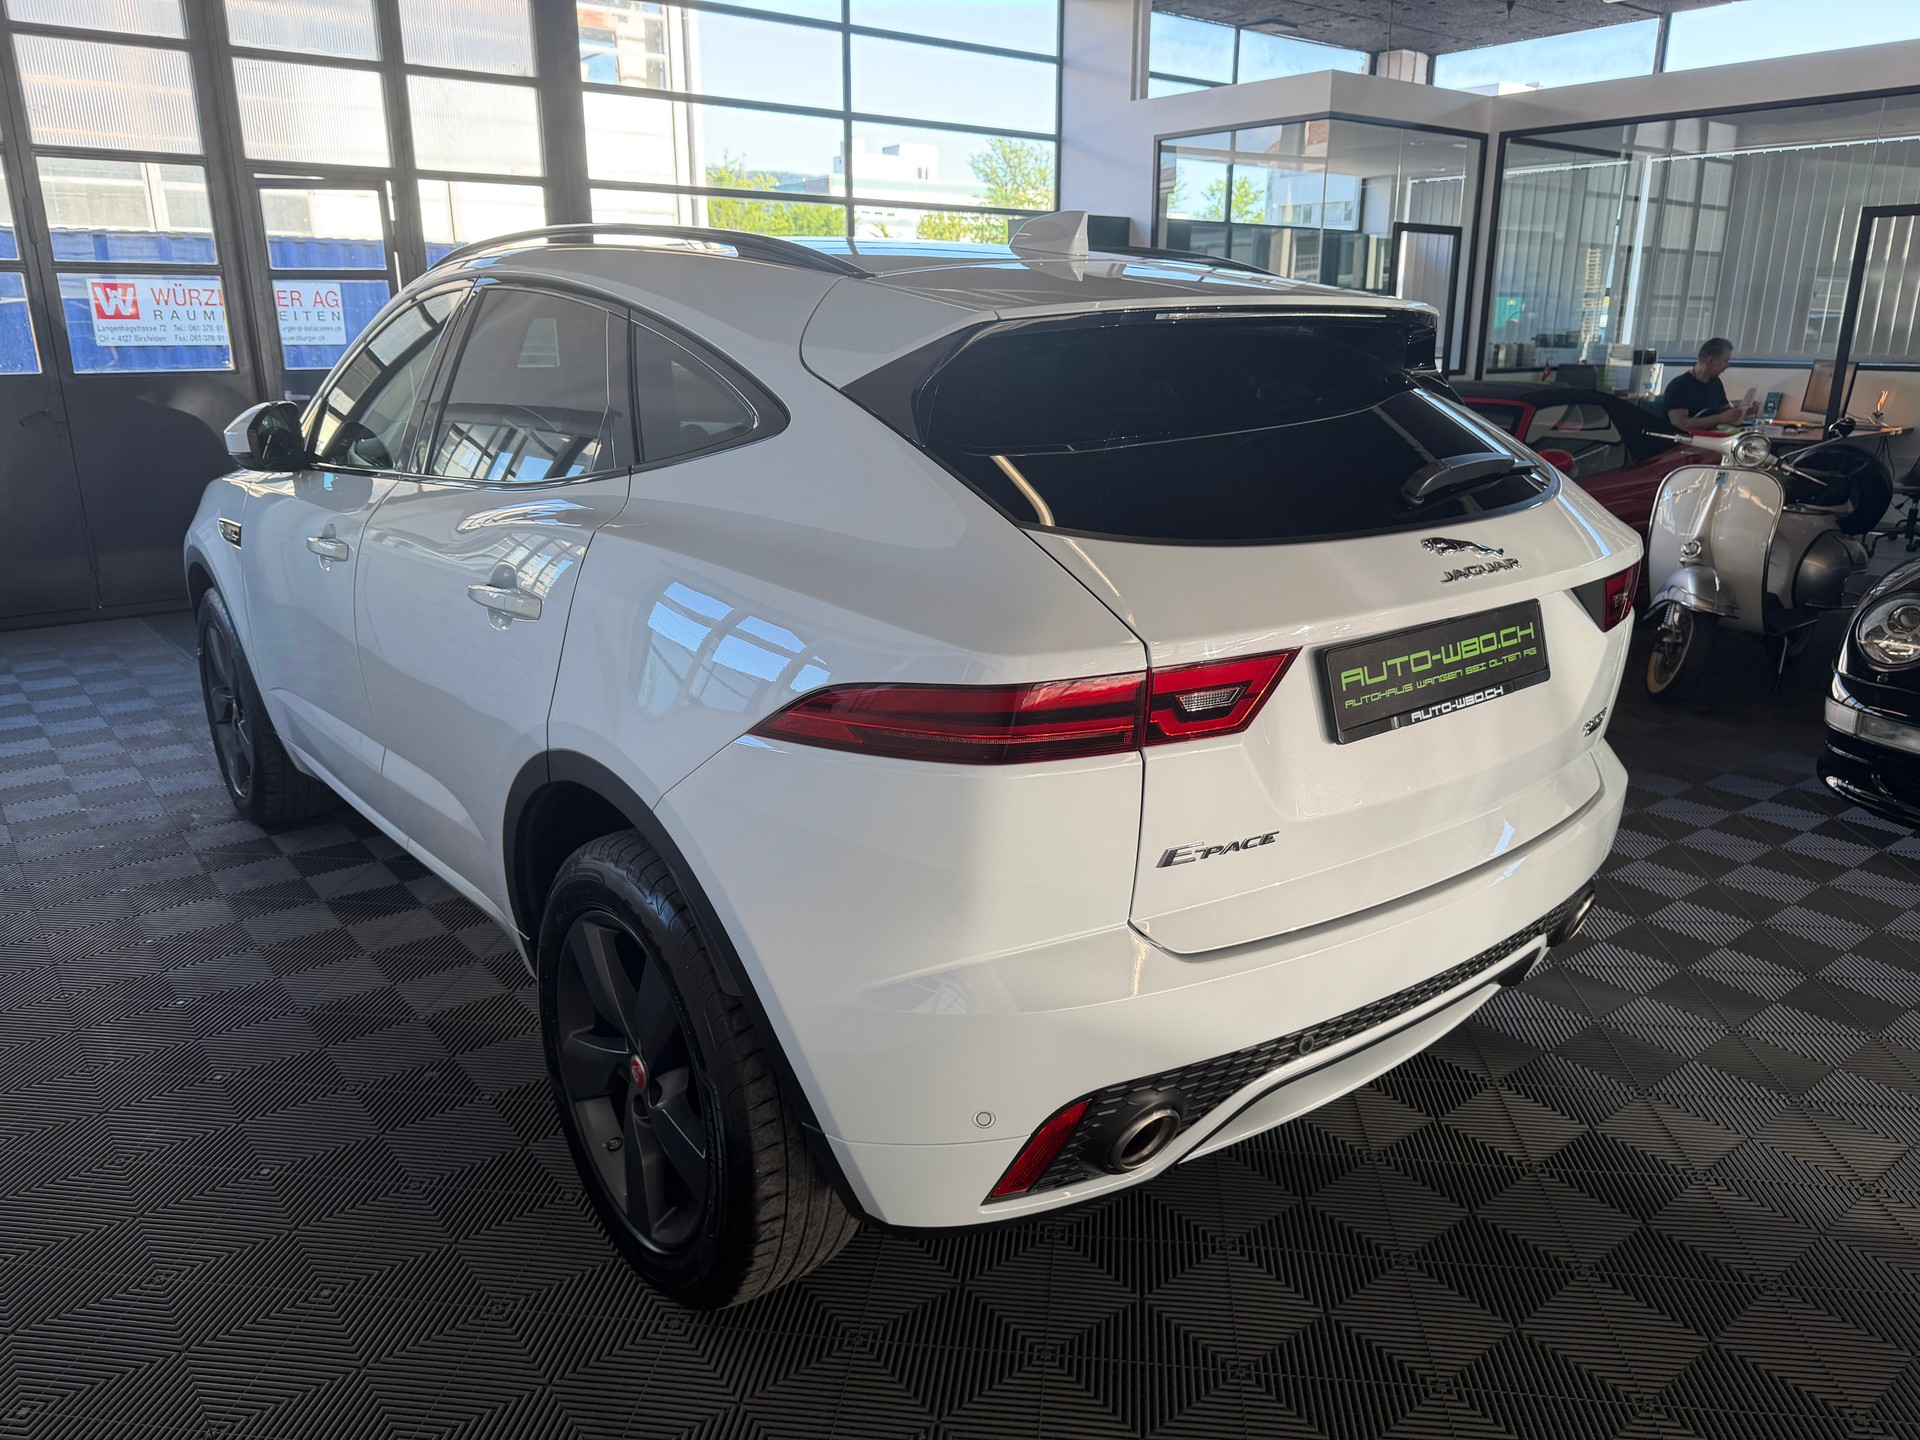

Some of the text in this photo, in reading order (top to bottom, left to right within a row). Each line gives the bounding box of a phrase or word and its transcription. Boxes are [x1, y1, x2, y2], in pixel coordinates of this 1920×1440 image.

[312, 290, 340, 308] AG
[1440, 558, 1521, 584] JAGUAR
[1341, 622, 1535, 691] AUTO-WBO.CH
[1345, 647, 1537, 709] AUTOHAUS WANGEN BEI OLTEN AG
[1411, 685, 1504, 723] AUTO-WBO.CH
